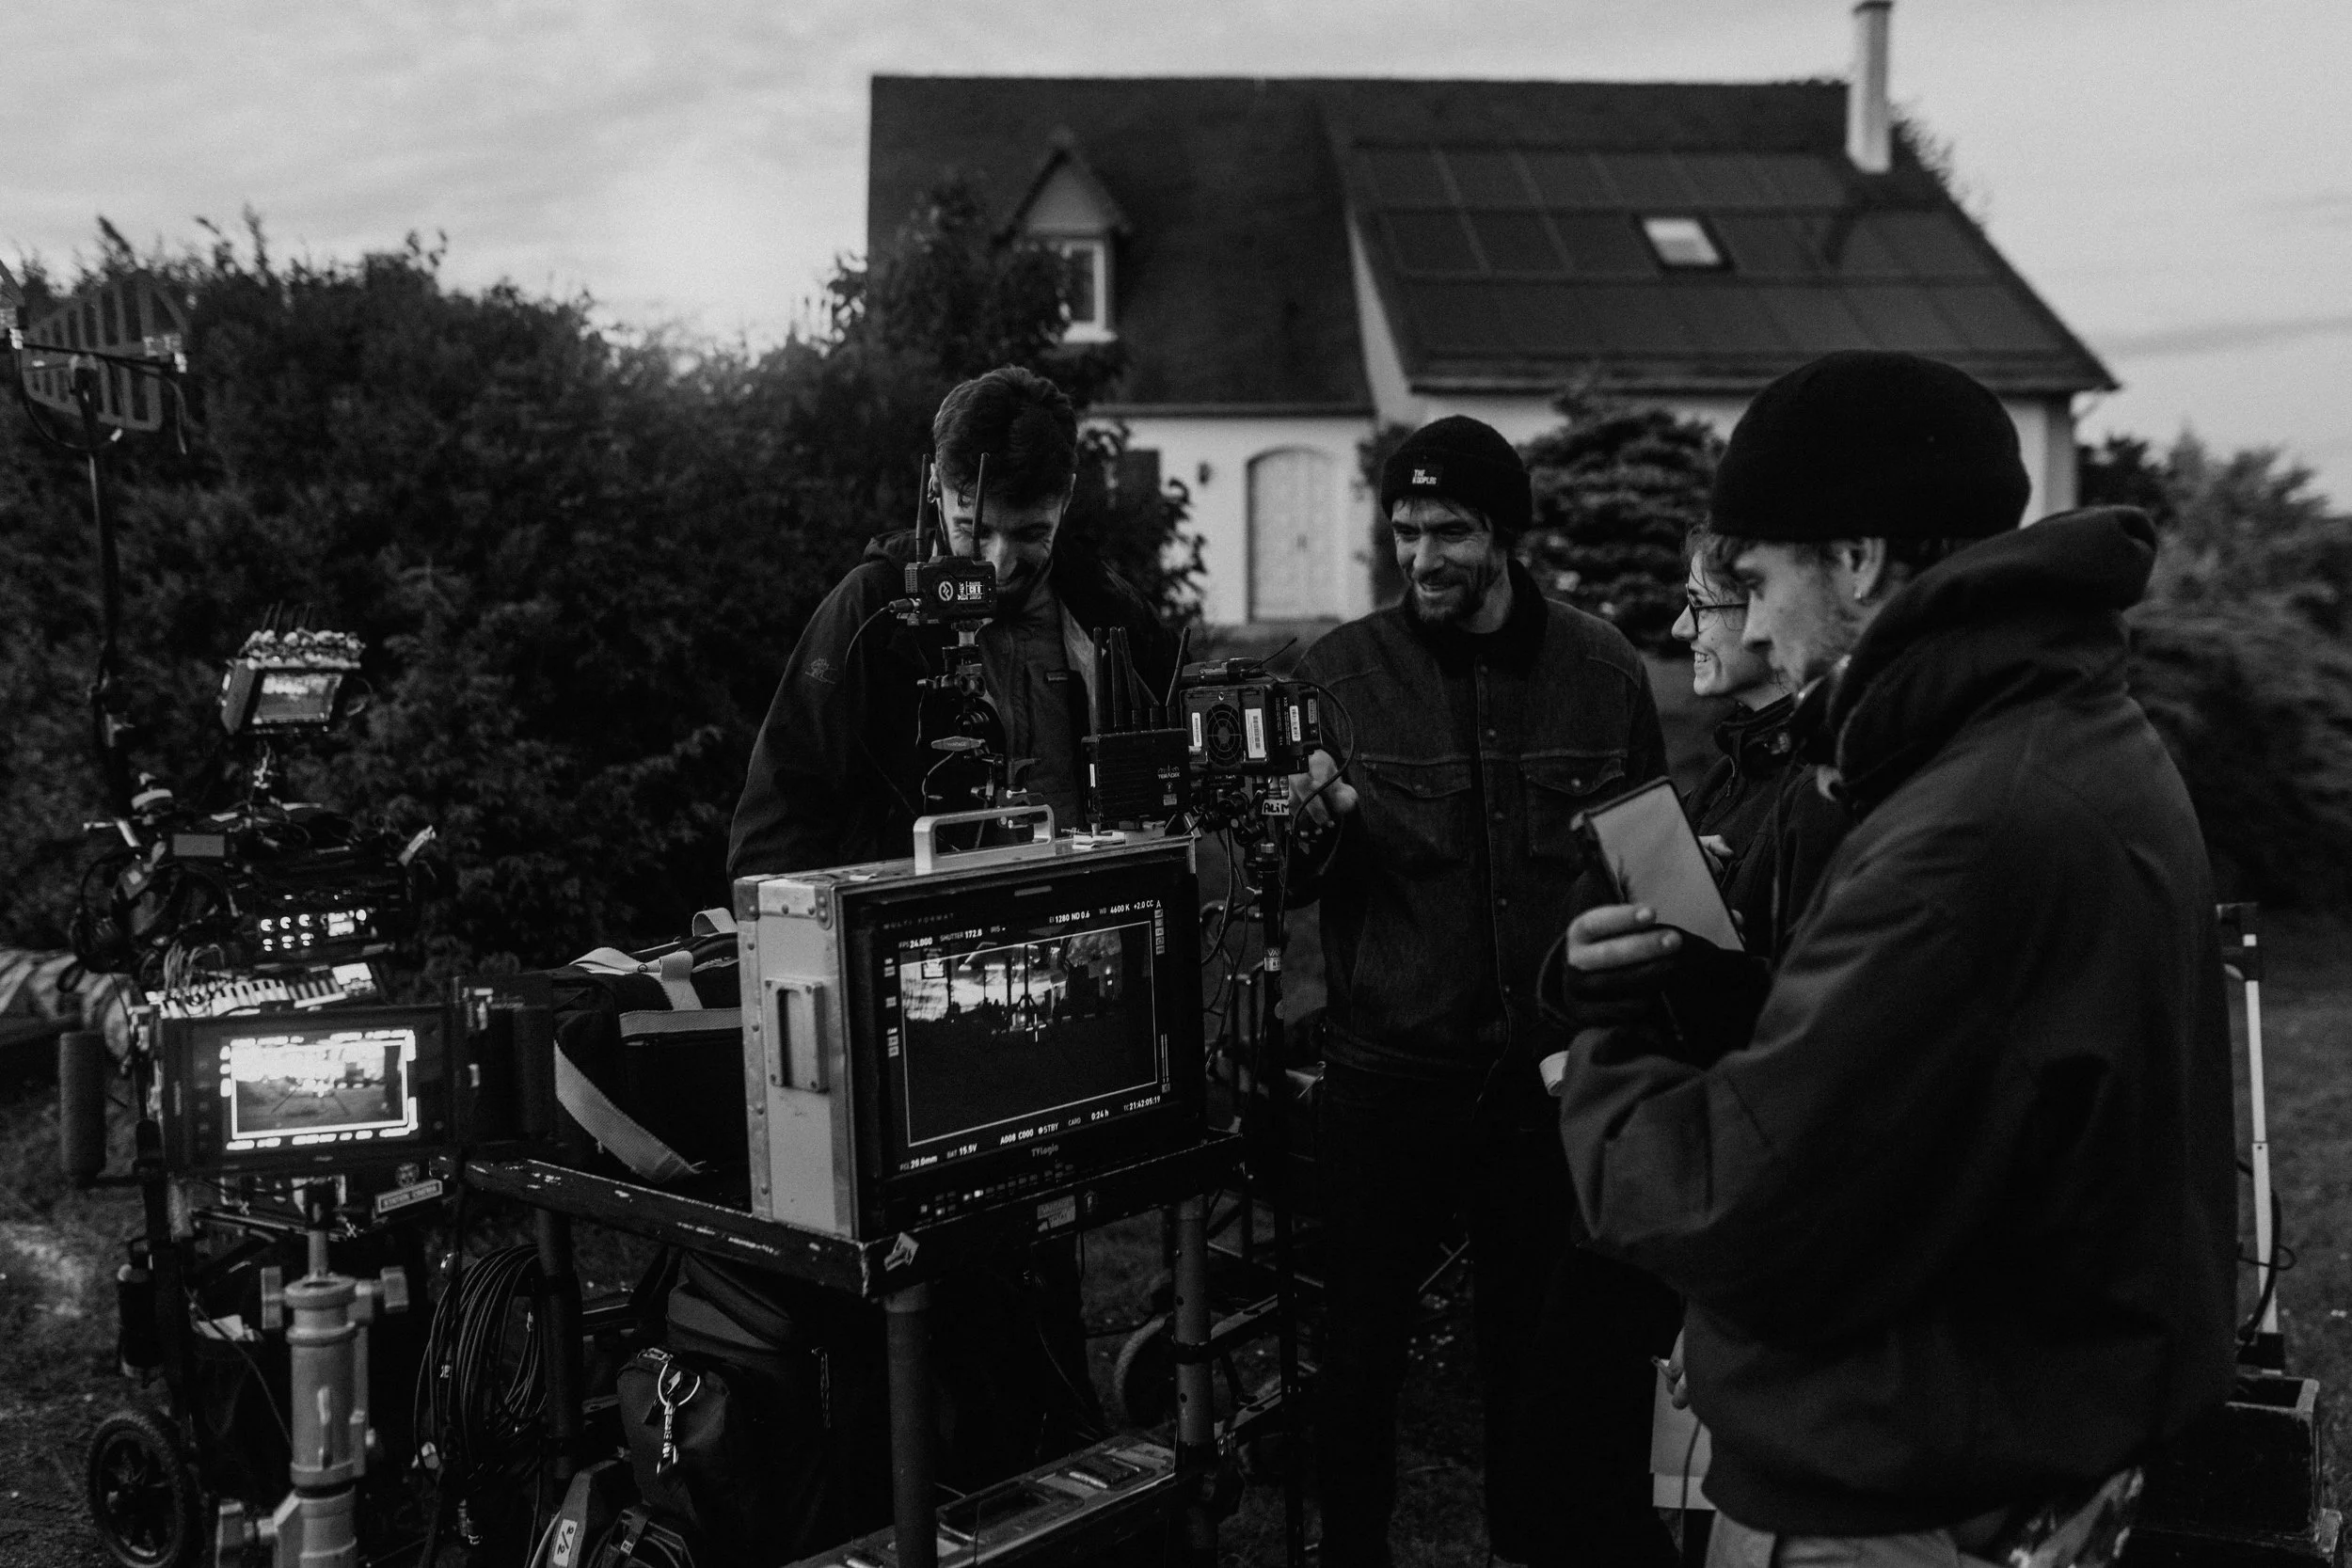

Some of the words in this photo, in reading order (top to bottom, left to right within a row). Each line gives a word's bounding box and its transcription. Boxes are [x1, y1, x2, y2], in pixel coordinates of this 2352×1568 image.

[1055, 912, 1071, 924] 1280
[1071, 911, 1081, 921] ND
[1080, 910, 1090, 919] 0.6
